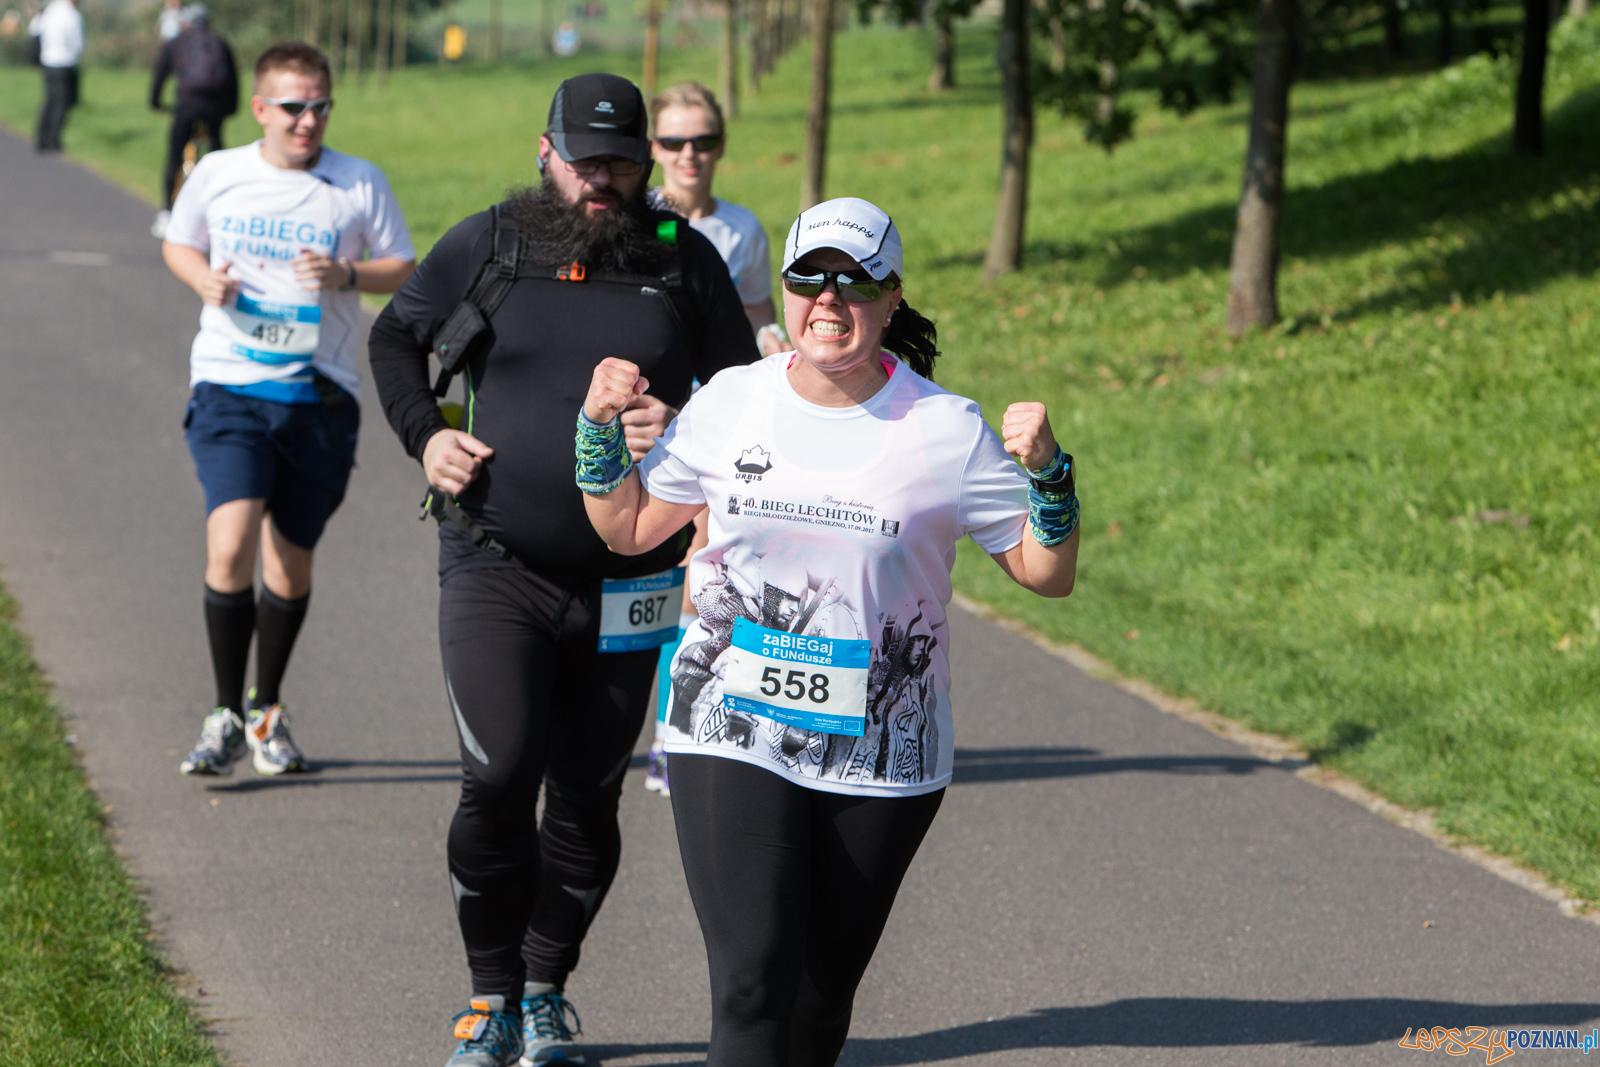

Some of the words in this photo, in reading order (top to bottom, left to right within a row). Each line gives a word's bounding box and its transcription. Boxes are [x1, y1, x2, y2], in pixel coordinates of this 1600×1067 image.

[806, 220, 829, 232] run
[832, 218, 874, 238] happy
[251, 322, 295, 346] 487
[735, 473, 763, 481] URBIS
[743, 497, 758, 509] 40.
[761, 500, 795, 513] BIEG
[798, 504, 877, 526] LECHITÓW
[815, 518, 847, 529] GNIEZNO,
[848, 524, 875, 534] 17.09.2017
[629, 595, 669, 627] 687
[763, 634, 834, 656] zaBIEGaj
[773, 648, 833, 665] FUNdusze
[760, 666, 830, 704] 558
